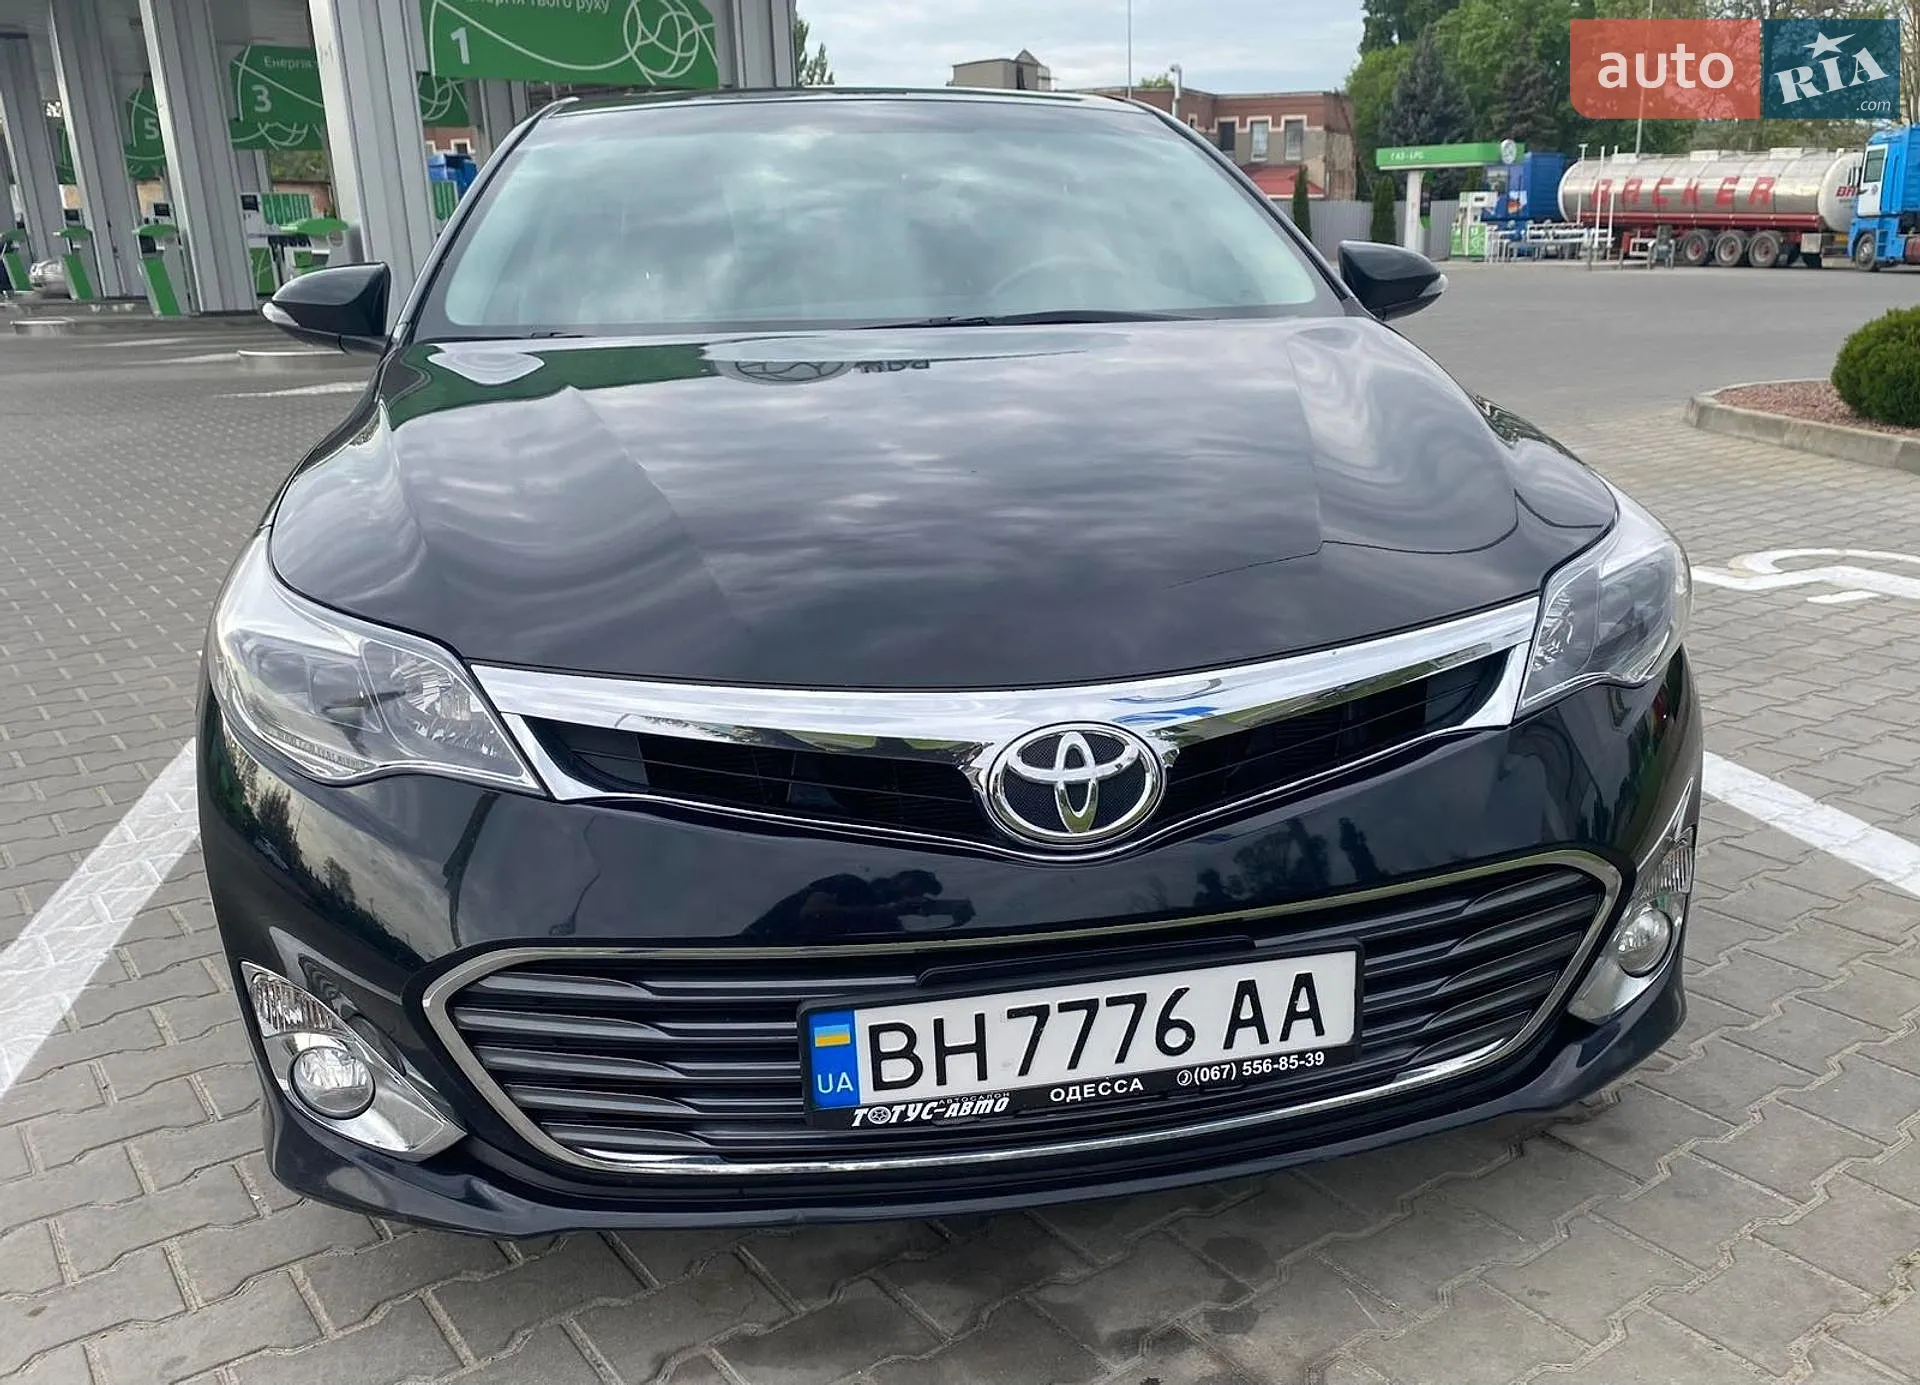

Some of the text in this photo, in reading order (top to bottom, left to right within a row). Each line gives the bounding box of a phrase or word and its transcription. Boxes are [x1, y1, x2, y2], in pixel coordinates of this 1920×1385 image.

[450, 27, 470, 65] 1
[251, 84, 272, 113] 3
[143, 117, 161, 140] 5
[1006, 986, 1196, 1077] 7776
[1222, 971, 1326, 1051] AA
[1194, 1051, 1325, 1086] (067) 556-85-39
[816, 1072, 855, 1095] UA
[1050, 1077, 1144, 1102] ОДЕССА
